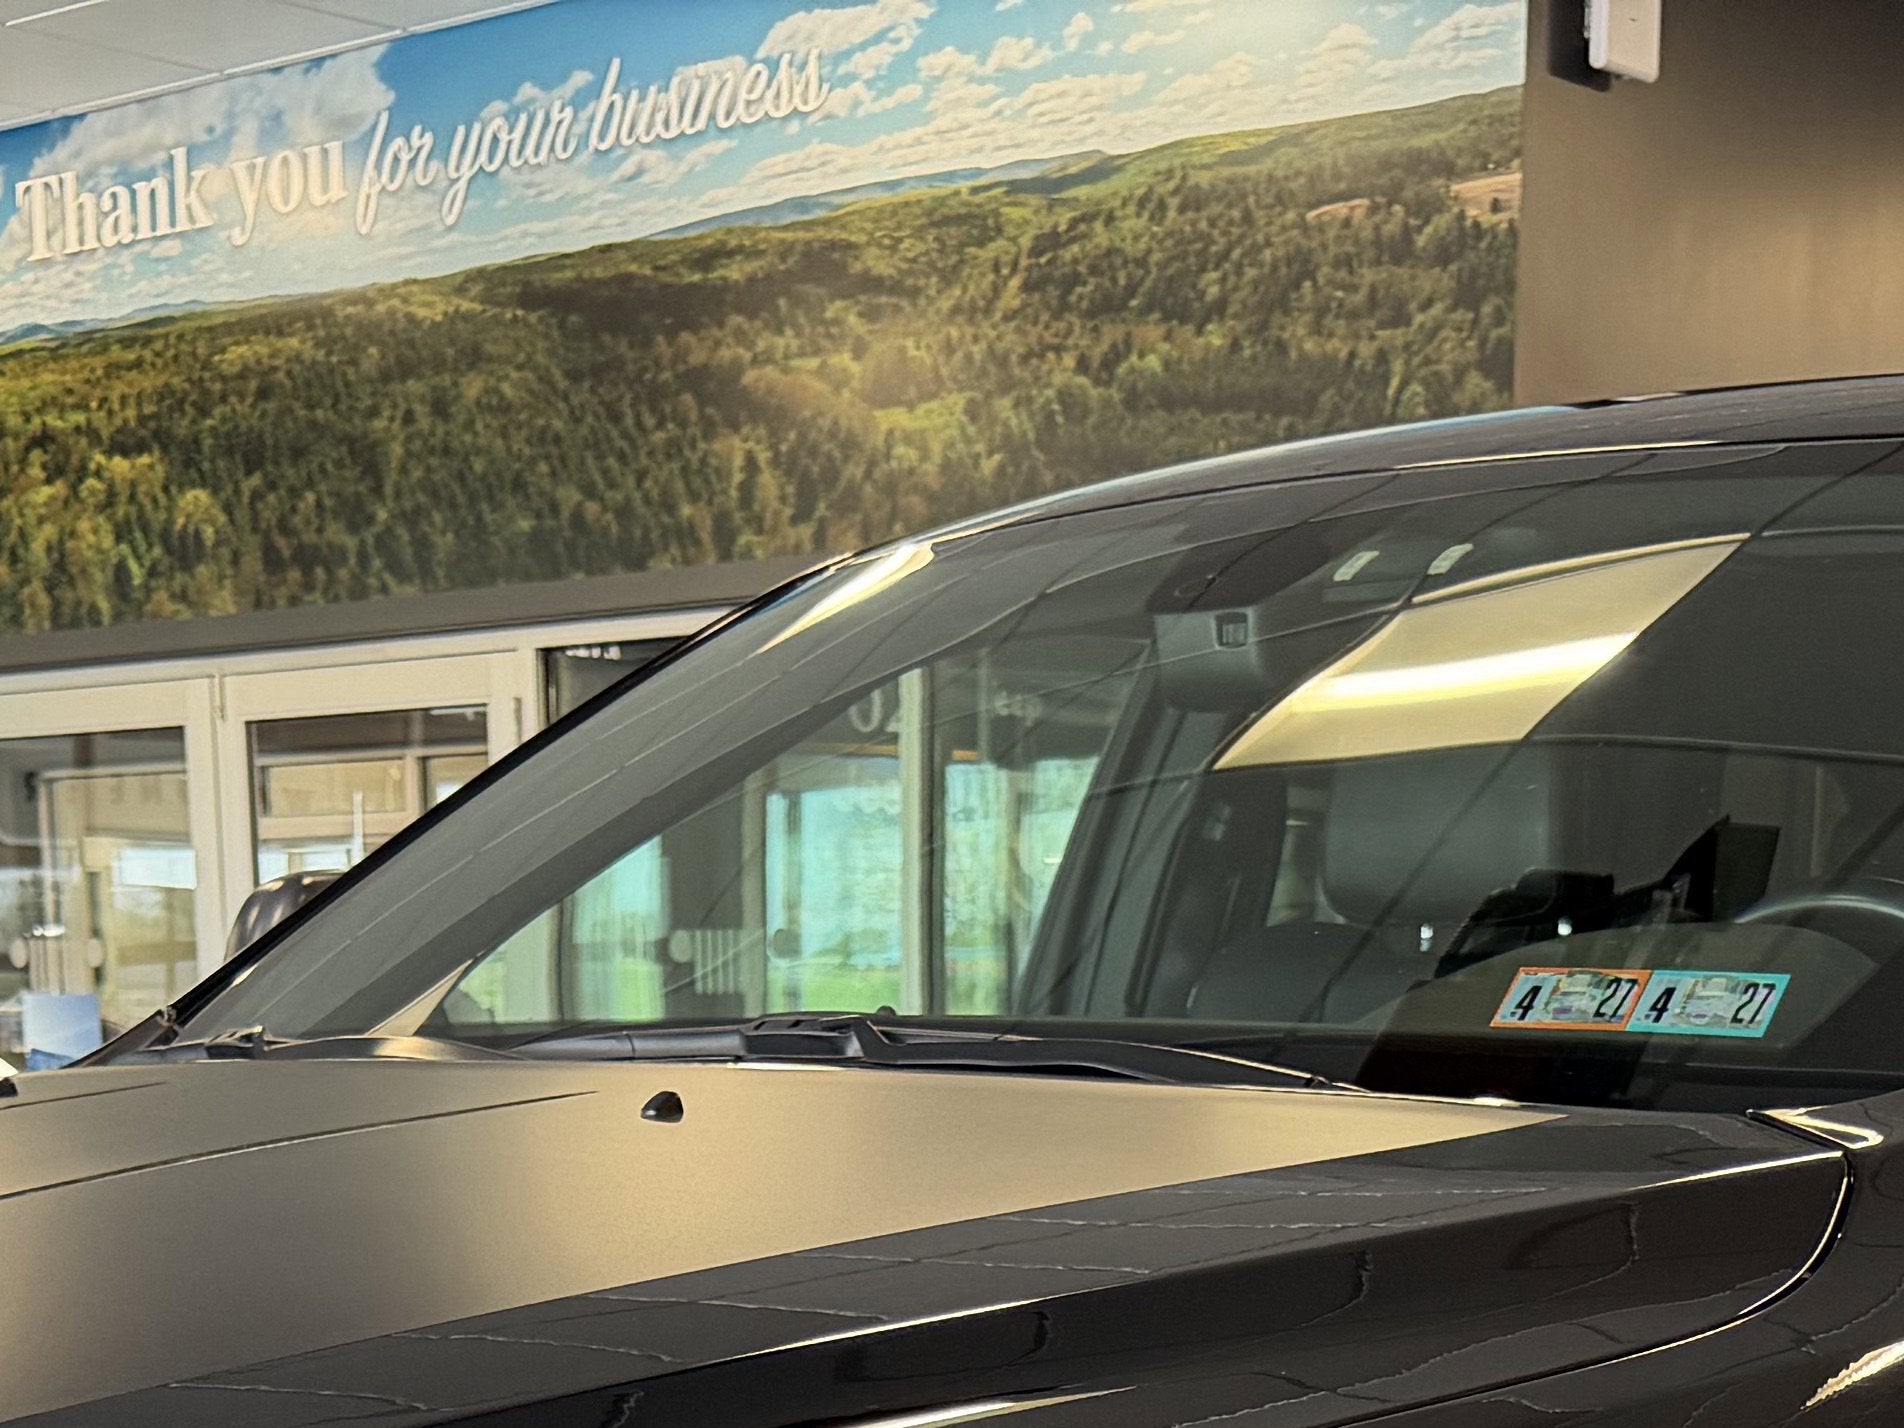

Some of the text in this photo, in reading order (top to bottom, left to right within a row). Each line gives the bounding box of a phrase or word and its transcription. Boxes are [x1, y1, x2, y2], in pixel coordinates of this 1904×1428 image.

[14, 46, 831, 263] Thank you for your business
[1515, 977, 1639, 1021] 4 27
[1650, 983, 1776, 1024] 4 27
